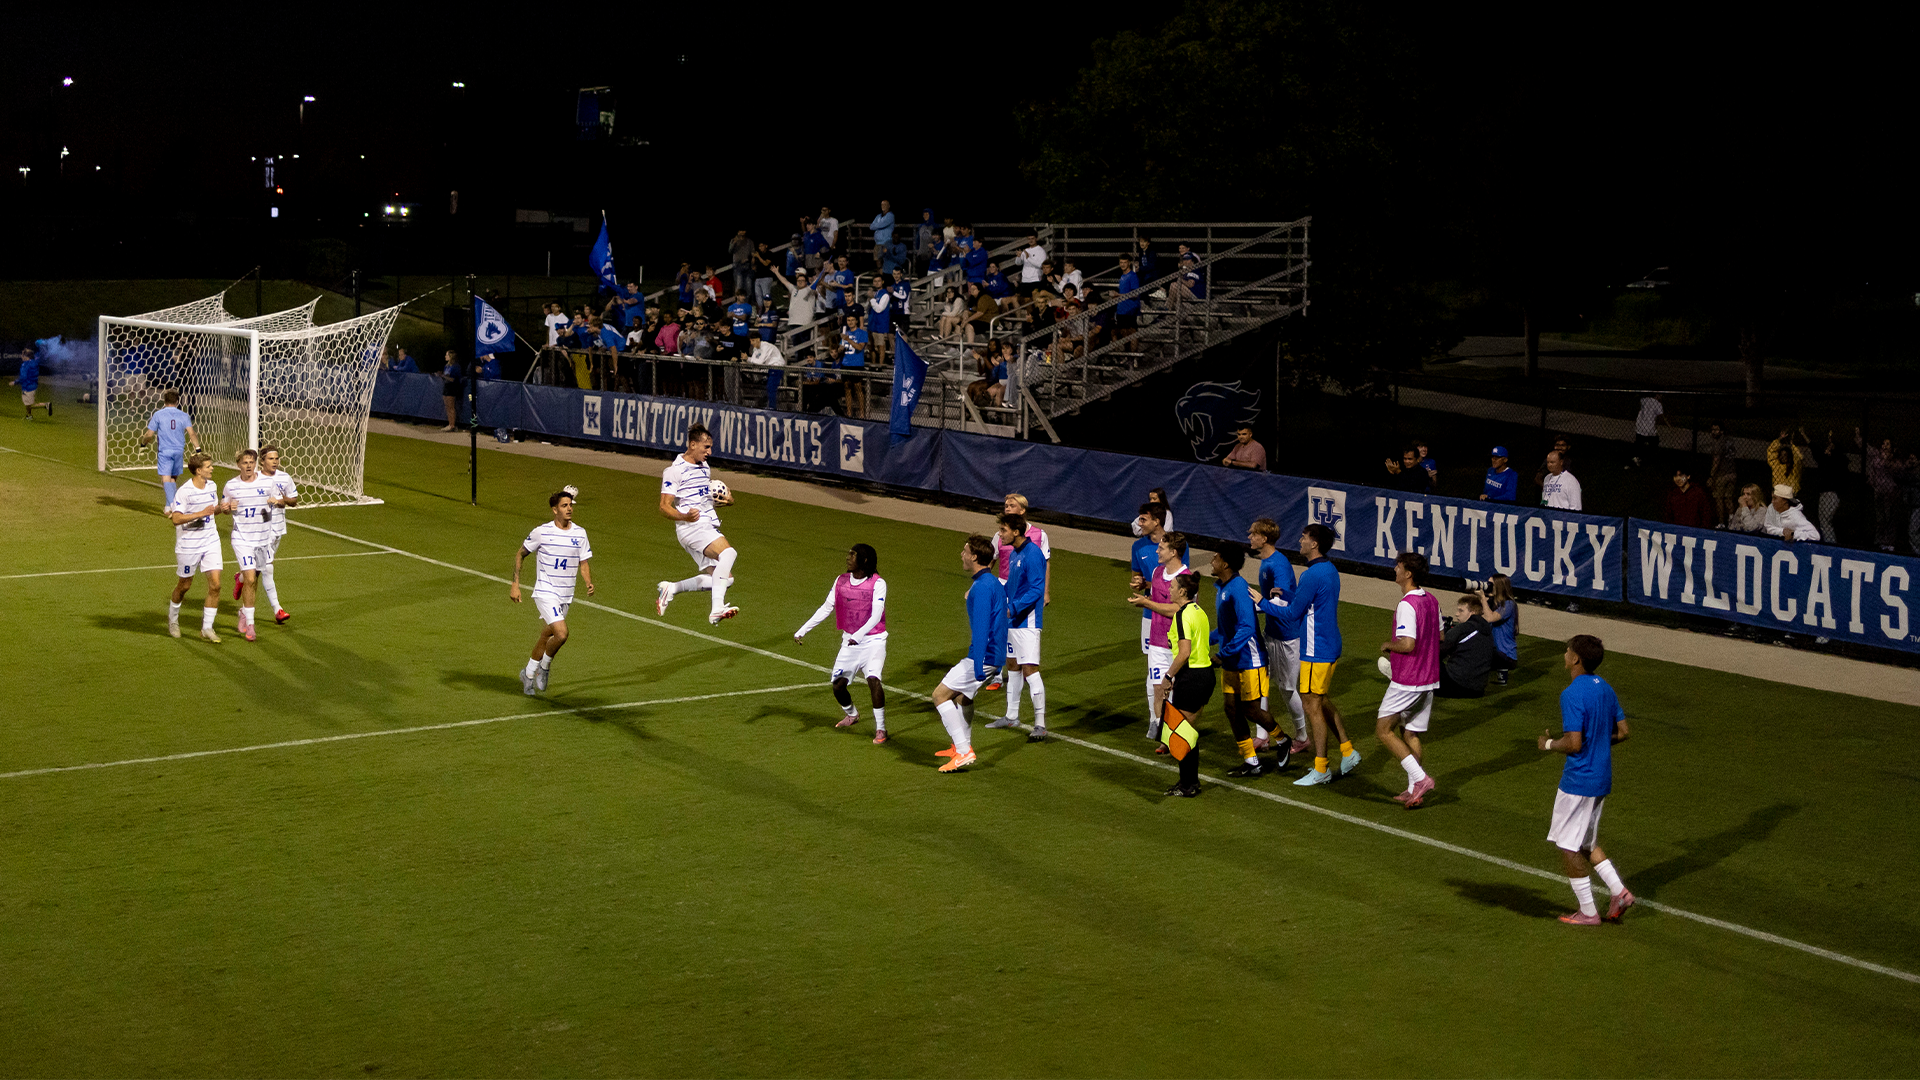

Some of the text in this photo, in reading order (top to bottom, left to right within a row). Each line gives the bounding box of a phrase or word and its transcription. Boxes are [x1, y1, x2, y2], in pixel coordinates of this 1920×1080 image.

[585, 402, 599, 429] UK
[170, 420, 176, 430] 0
[720, 409, 822, 466] WILDCATS
[244, 508, 256, 518] 17
[1311, 496, 1343, 541] UK
[242, 556, 254, 566] 17
[554, 558, 568, 570] 14
[184, 566, 190, 574] 8
[1374, 496, 1910, 640] KENTUCKY WILDCATS
[1149, 668, 1160, 680] 12
